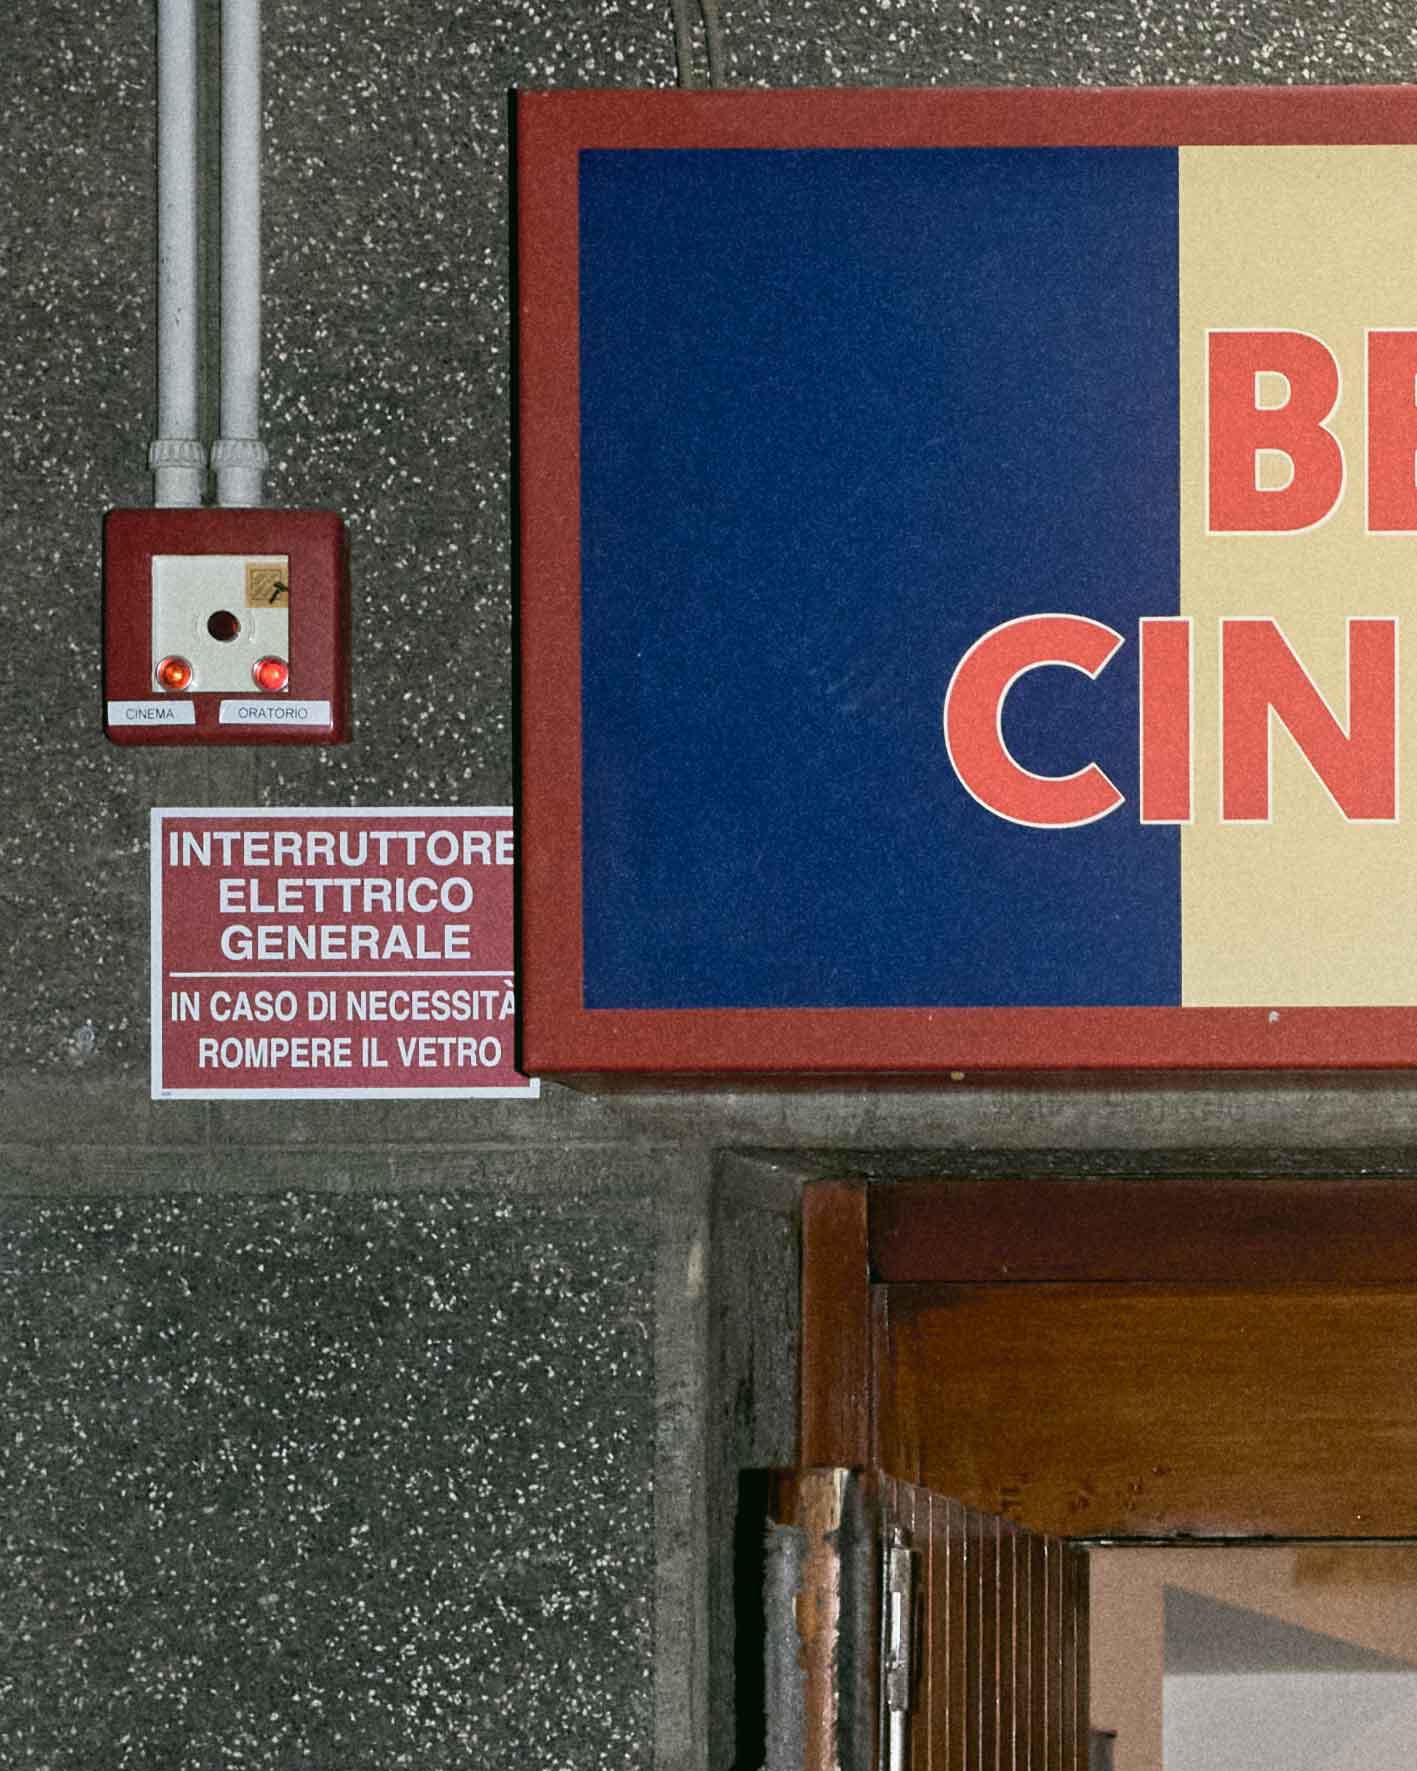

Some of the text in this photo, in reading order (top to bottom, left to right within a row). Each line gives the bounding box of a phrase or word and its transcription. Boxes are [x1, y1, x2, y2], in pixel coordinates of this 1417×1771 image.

[125, 706, 175, 720] CINEMA
[238, 706, 309, 720] ORATORIO
[169, 829, 514, 867] INTERRUTTORE
[219, 876, 474, 913] ELETTRICO
[220, 924, 471, 961] GENERALE
[171, 979, 515, 1022] IN CASO DI NECESSITÀ
[198, 1035, 502, 1069] ROMPERE IL VETRO
